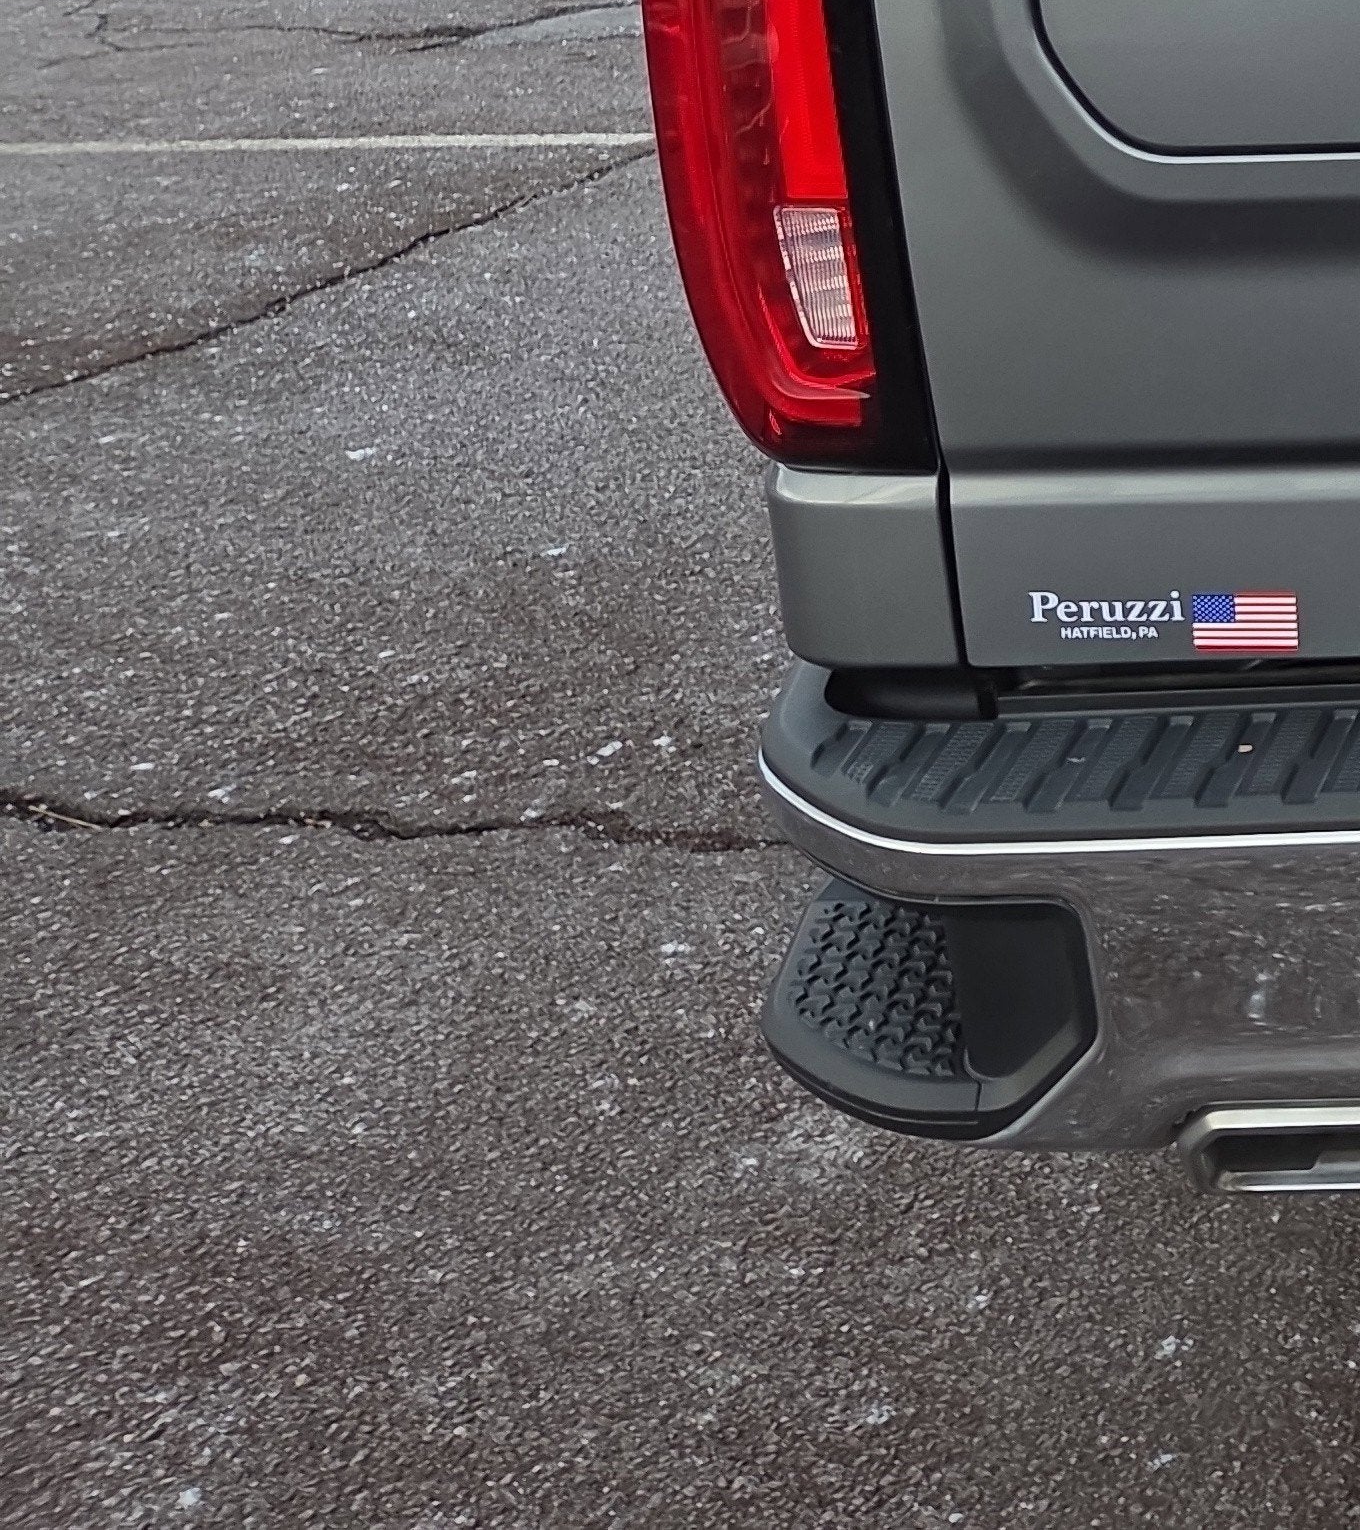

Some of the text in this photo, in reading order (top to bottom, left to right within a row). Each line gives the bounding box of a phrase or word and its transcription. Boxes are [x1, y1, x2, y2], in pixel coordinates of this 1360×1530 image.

[1028, 590, 1185, 623] Peruzzi
[1060, 626, 1159, 641] HATFIELD, PA
